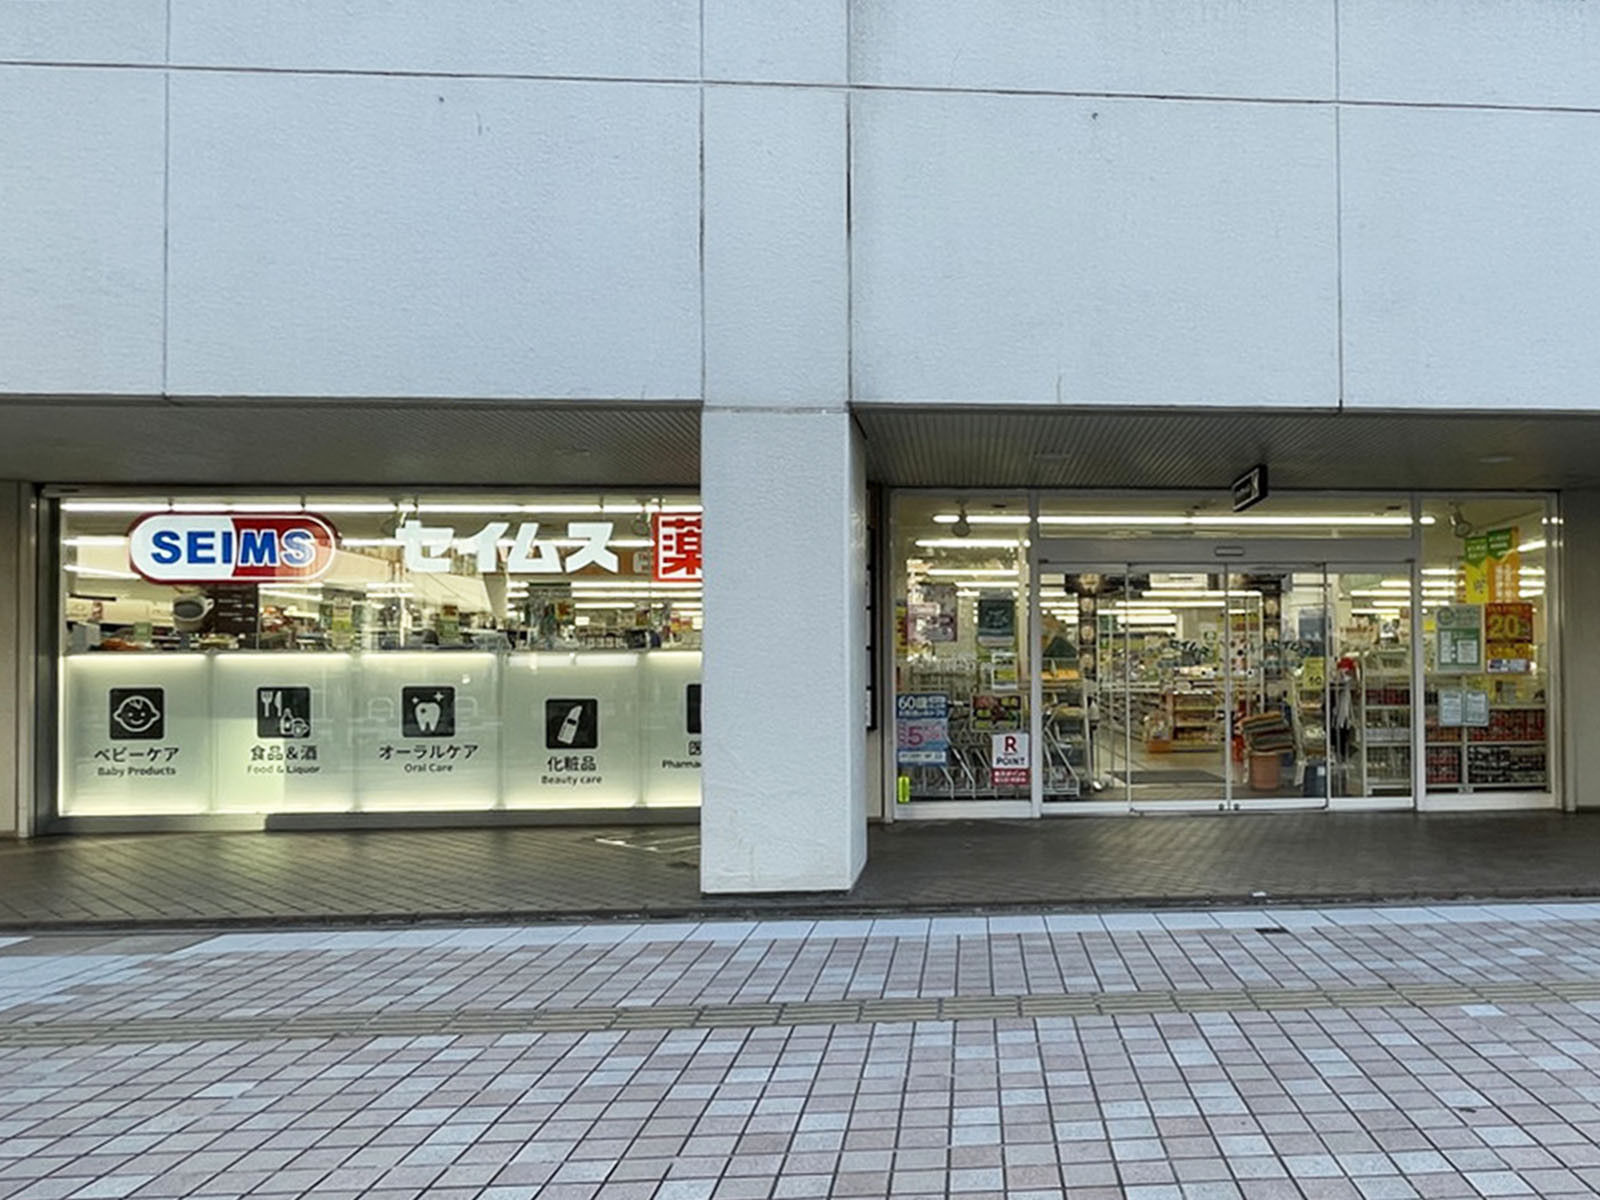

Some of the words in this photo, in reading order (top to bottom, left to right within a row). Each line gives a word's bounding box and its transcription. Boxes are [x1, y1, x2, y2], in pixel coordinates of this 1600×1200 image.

[151, 528, 314, 567] SEIMS
[396, 520, 618, 573] セイムス
[1004, 735, 1017, 753] R
[94, 747, 179, 762] ベビーケア
[251, 745, 317, 761] 食品&酒
[379, 744, 478, 760] オーラルケア
[404, 763, 427, 773] Oral
[428, 763, 453, 772] Care
[548, 755, 597, 773] 化粧品
[996, 757, 1025, 766] POINT
[98, 767, 126, 777] Baby
[128, 766, 176, 775] Products
[247, 765, 273, 773] Food
[286, 765, 320, 774] Liquor
[541, 776, 578, 786] Beauty
[580, 776, 602, 784] care
